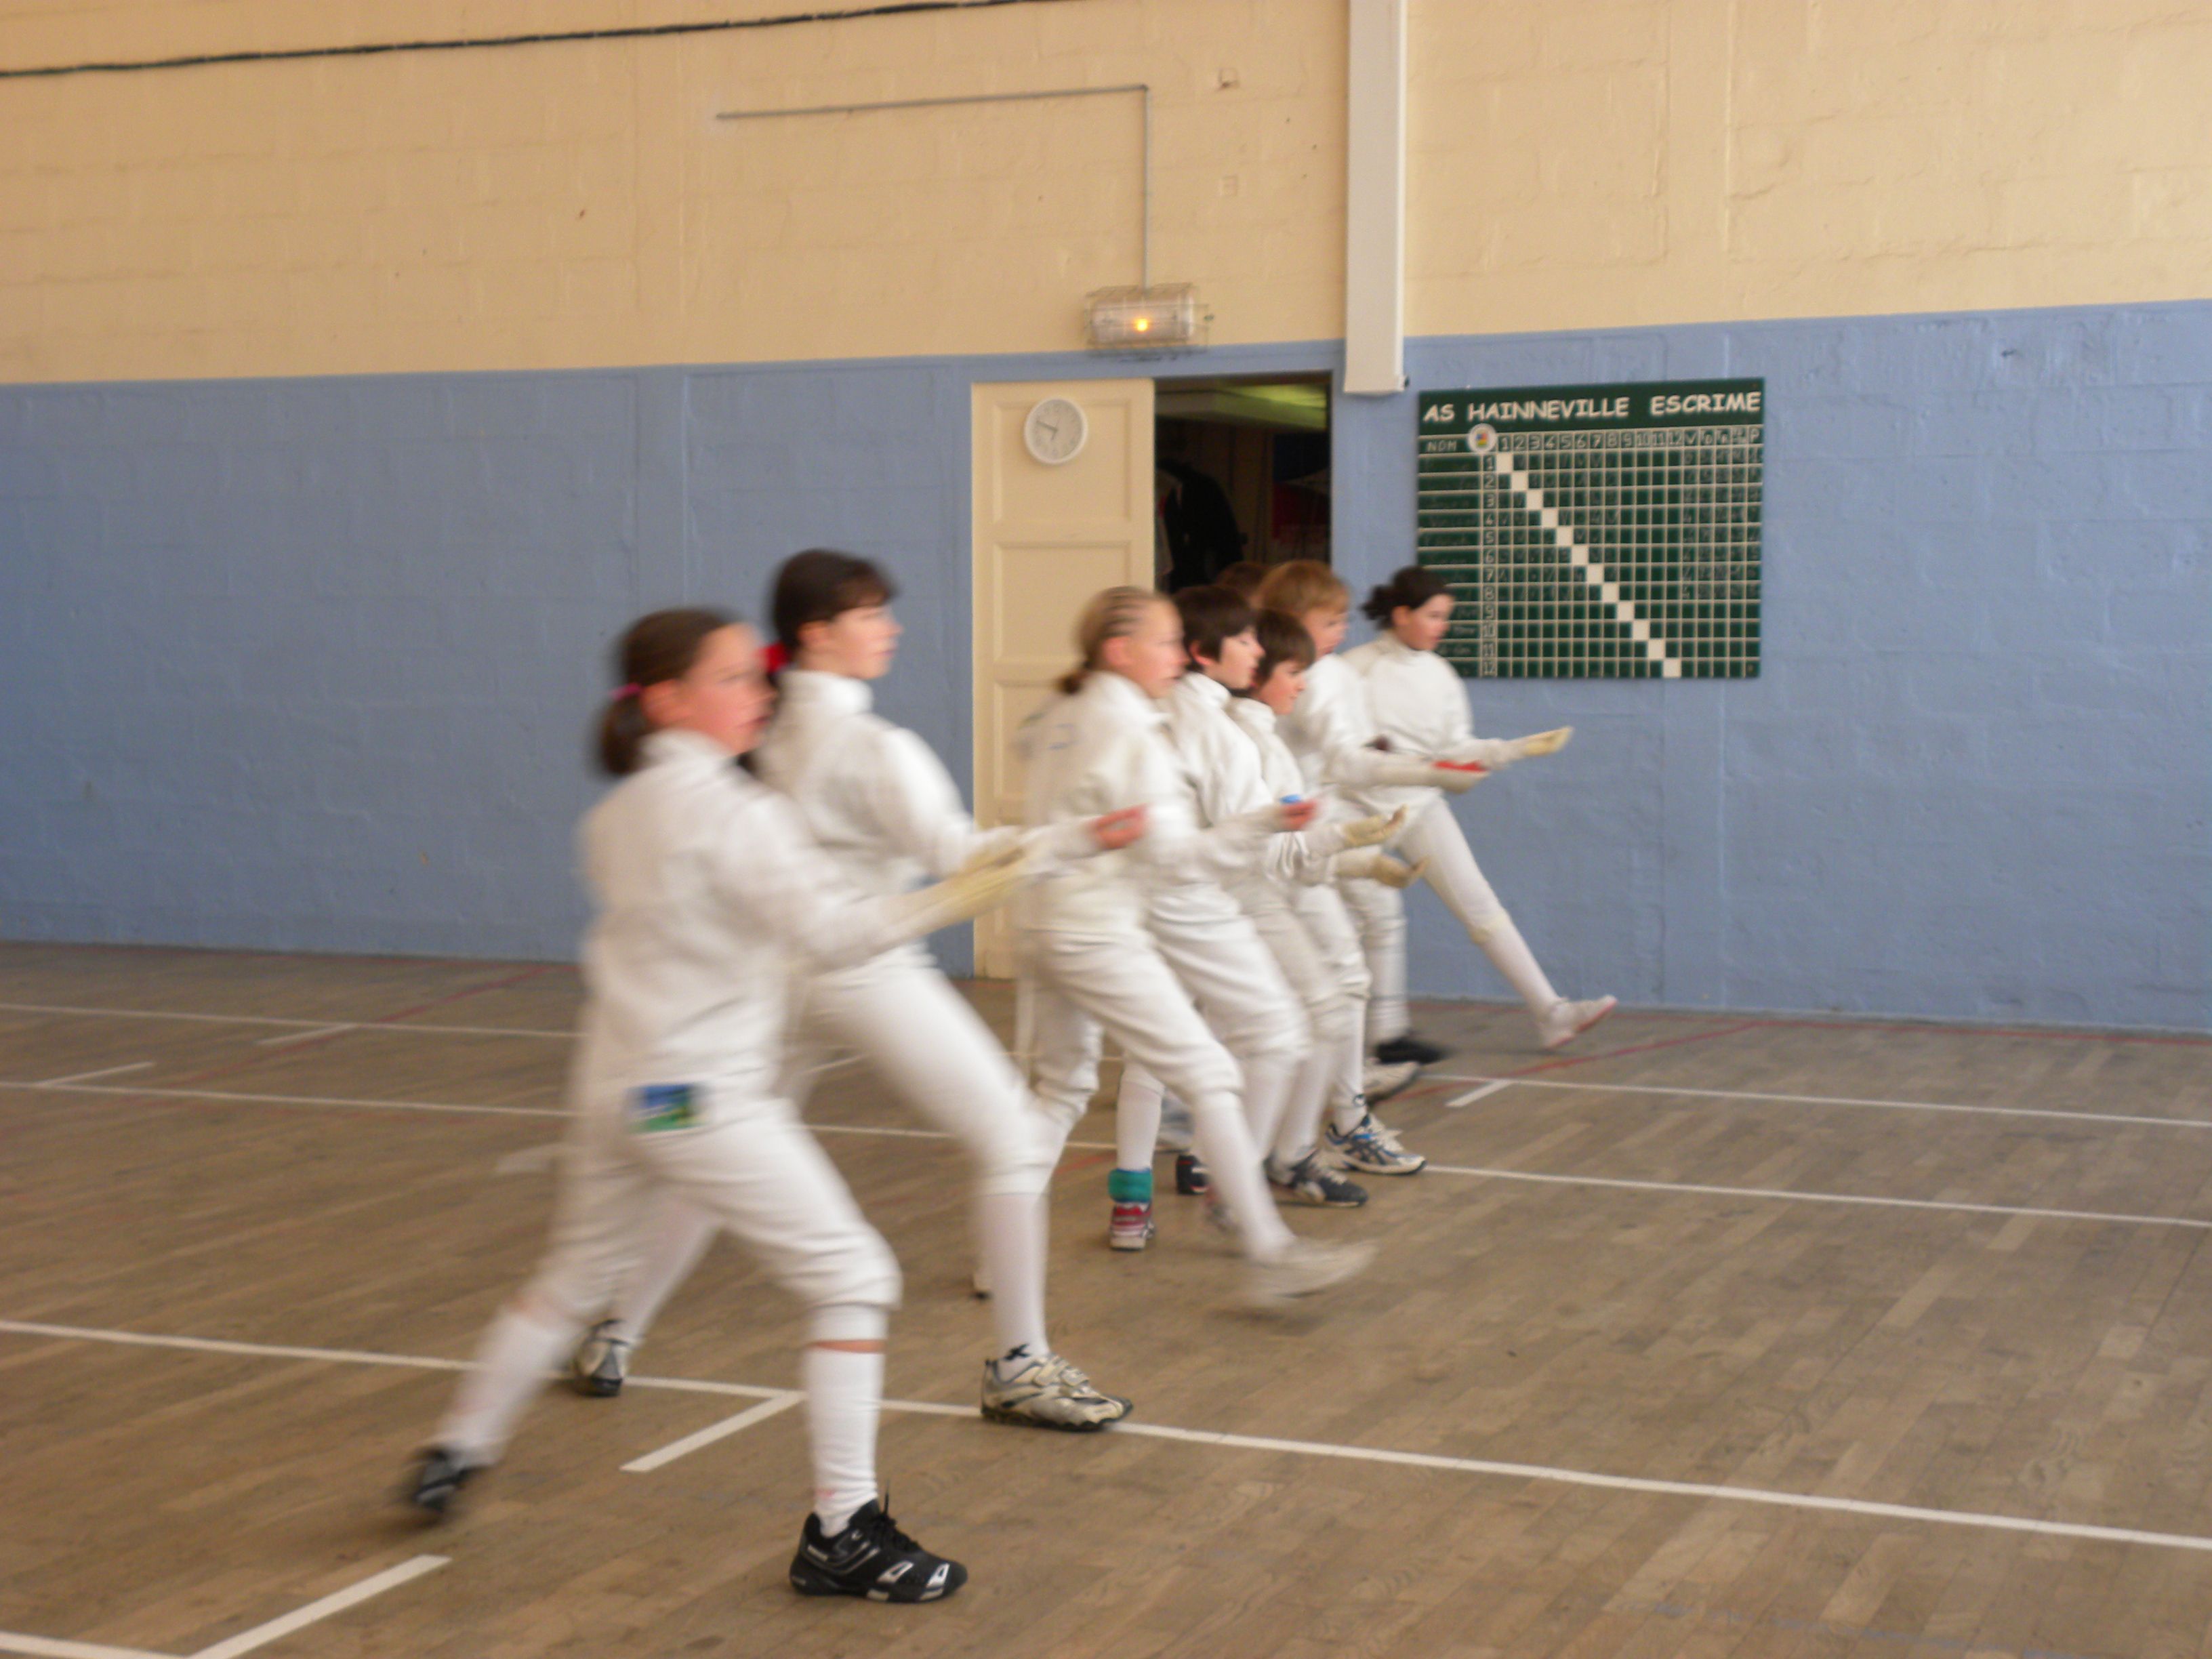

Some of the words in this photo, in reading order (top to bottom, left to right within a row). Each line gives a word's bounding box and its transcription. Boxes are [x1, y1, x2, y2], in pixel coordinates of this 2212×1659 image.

[1423, 403, 1455, 422] AS
[1467, 397, 1629, 422] HAINNEVILLE
[1650, 392, 1761, 416] ESCRIME
[1427, 440, 1457, 452] NOM
[1501, 435, 1509, 450] 1
[1514, 434, 1524, 451] 2
[1528, 433, 1541, 450] 3
[1545, 434, 1555, 449] 4
[1560, 433, 1572, 448] 5
[1576, 432, 1586, 449] 6
[1592, 432, 1603, 448] 7
[1607, 432, 1618, 447] 8
[1622, 431, 1632, 447] 9
[1637, 431, 1650, 447] 10
[1652, 431, 1666, 446] 11
[1668, 431, 1683, 446] 12
[1750, 428, 1760, 443] P
